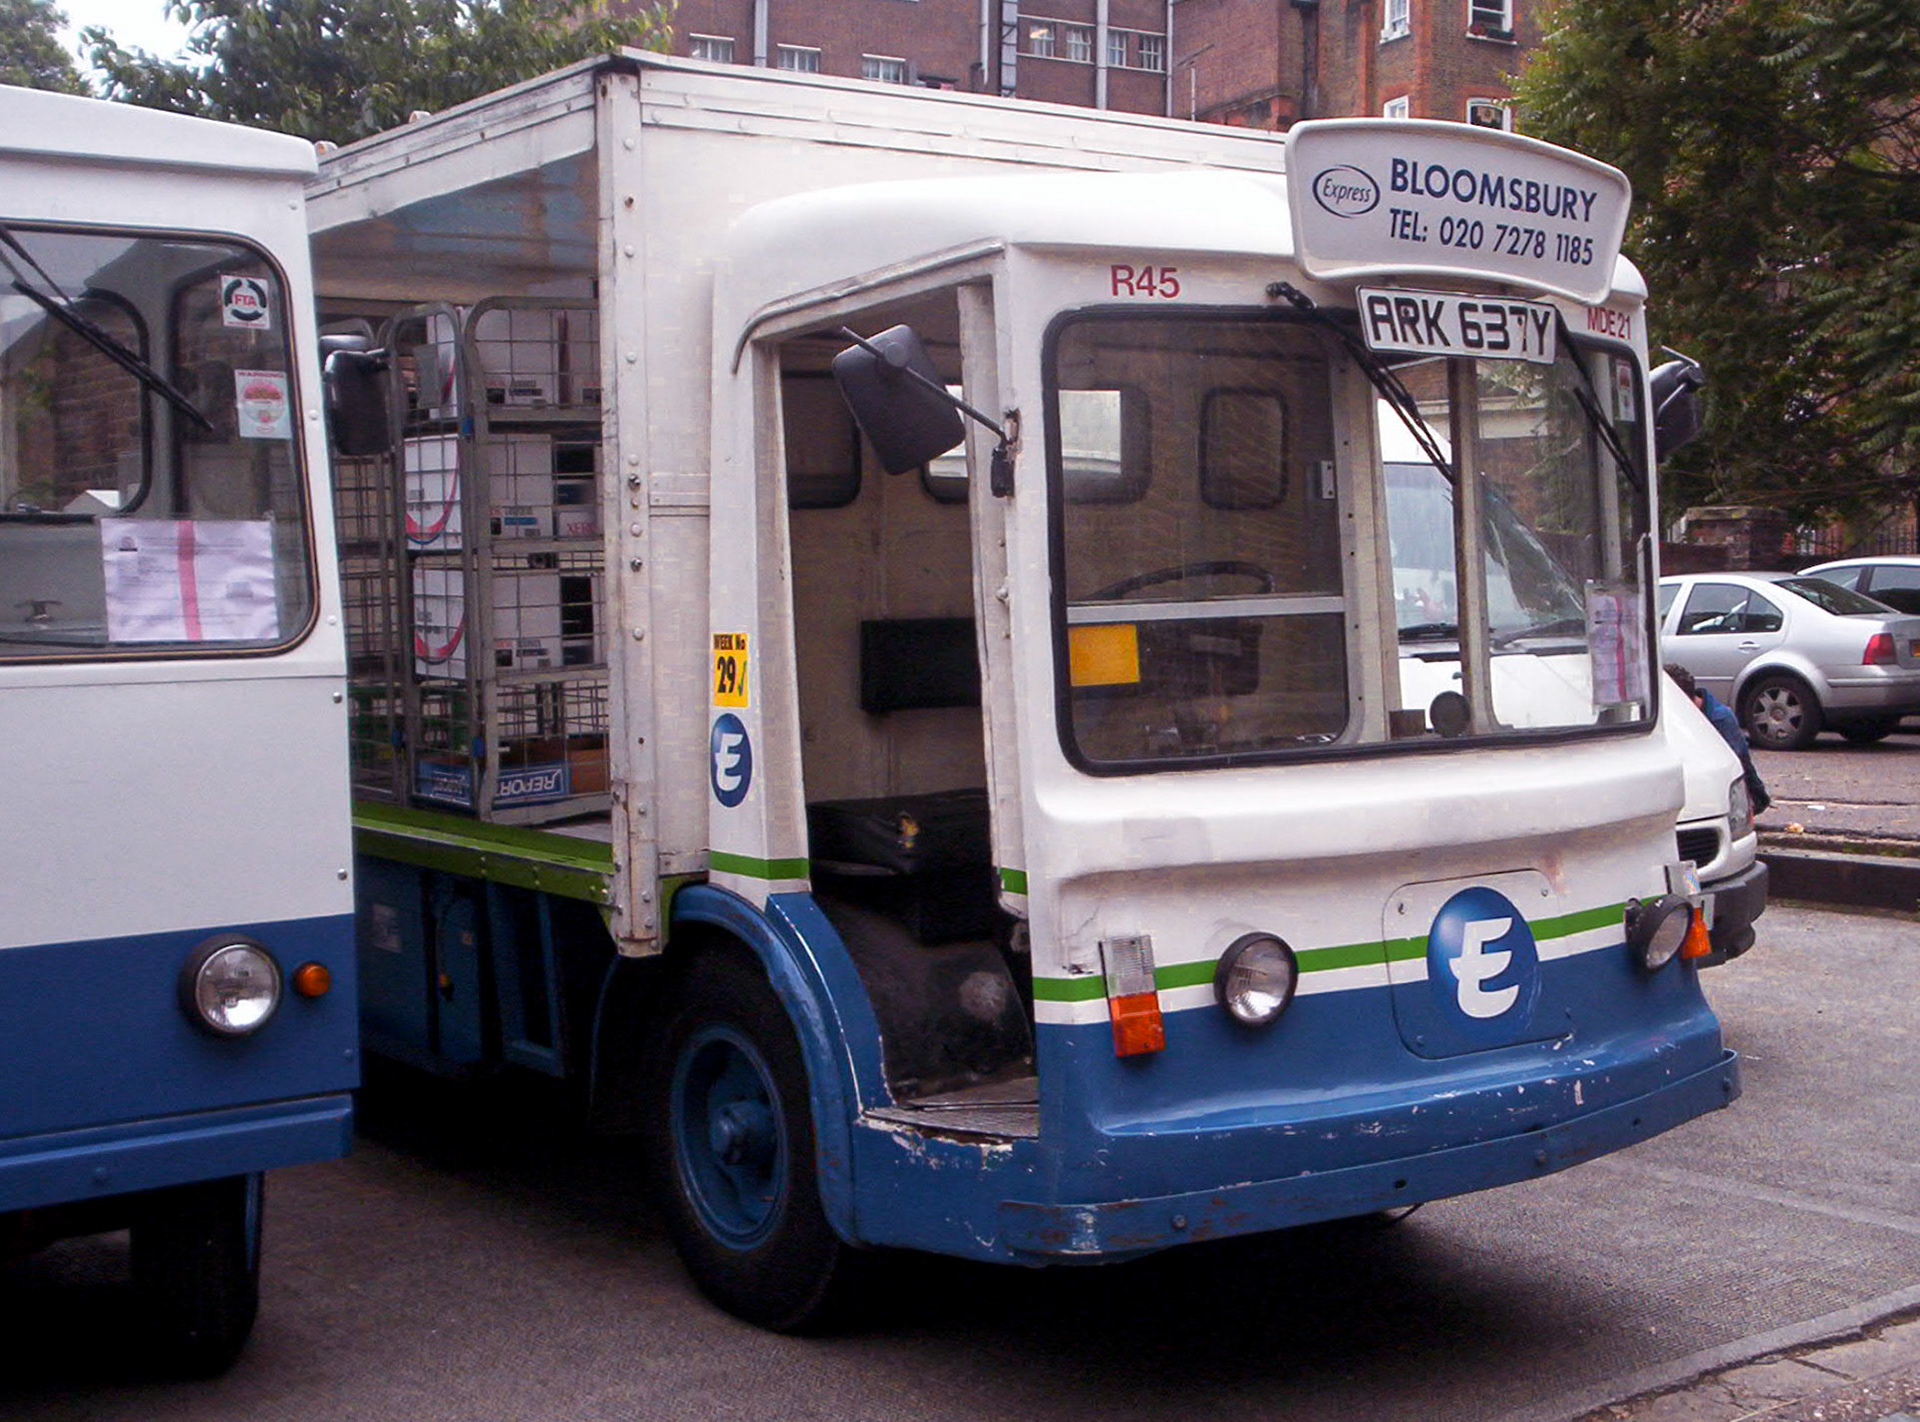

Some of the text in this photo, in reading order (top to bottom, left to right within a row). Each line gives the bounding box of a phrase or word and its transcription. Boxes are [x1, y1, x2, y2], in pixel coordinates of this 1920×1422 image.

[1322, 178, 1371, 205] Express
[1391, 158, 1597, 222] BLOOMSBURY
[1390, 207, 1594, 266] TEL: 020 7278 1185
[1111, 264, 1180, 298] R45
[234, 293, 257, 306] FTA
[1367, 295, 1551, 356] ARK 637Y
[713, 634, 733, 650] WEEK
[717, 656, 737, 693] 29
[496, 774, 558, 796] REPOR
